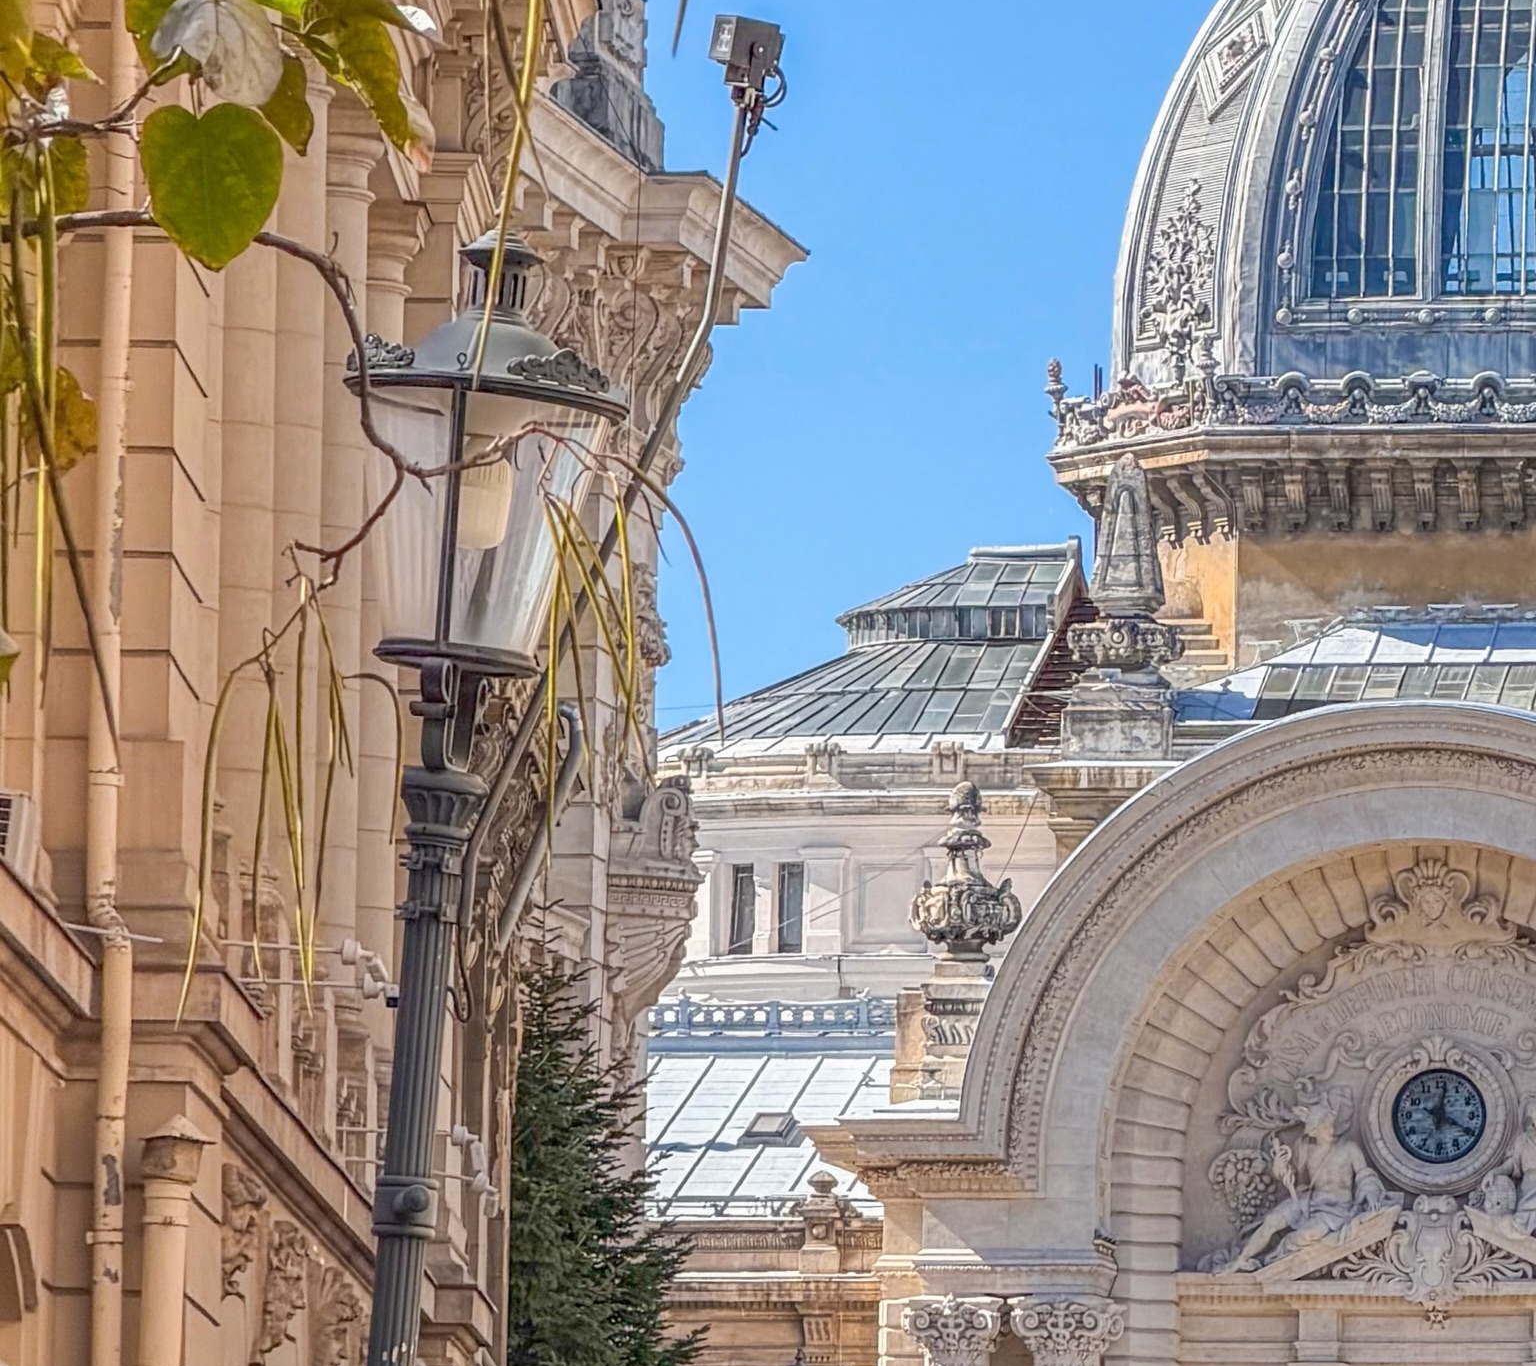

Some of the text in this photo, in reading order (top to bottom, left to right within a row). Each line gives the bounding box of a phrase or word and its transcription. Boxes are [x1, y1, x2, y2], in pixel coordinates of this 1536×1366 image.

[1377, 1002, 1511, 1039] ECONOMIE
[1265, 1026, 1320, 1087] CASA
[1421, 1084, 1431, 1094] 11
[1410, 1097, 1421, 1106] 10
